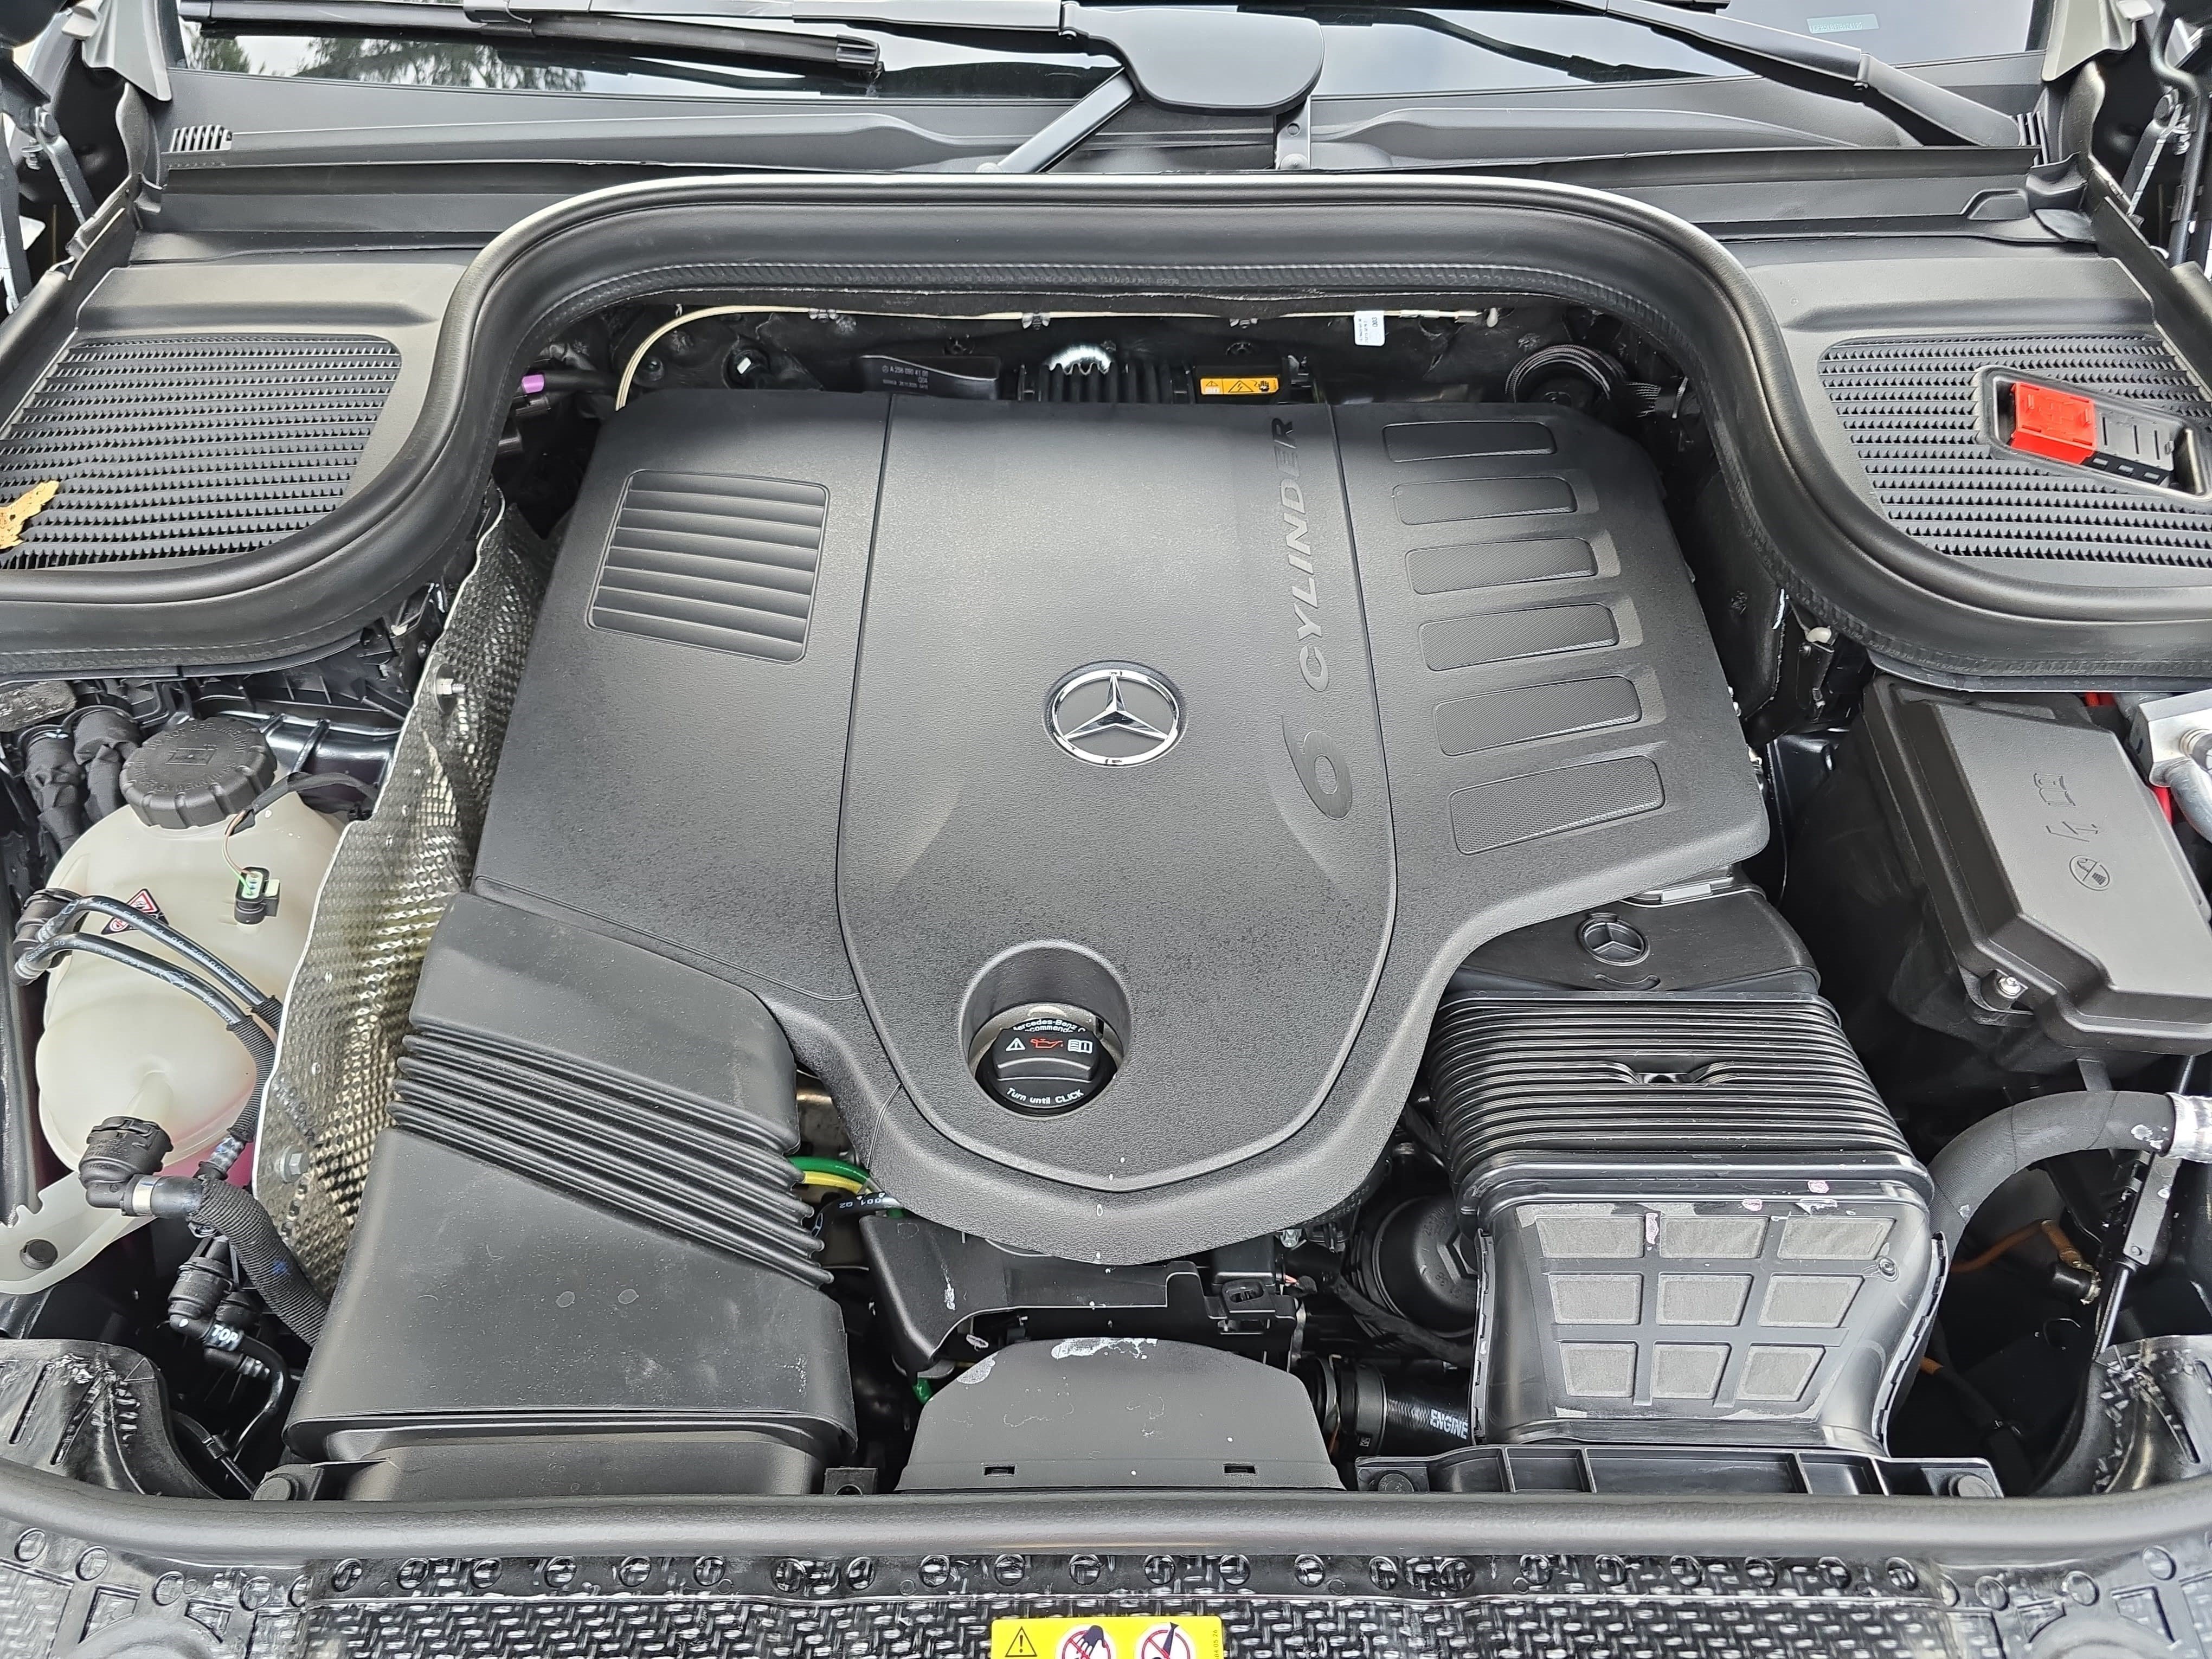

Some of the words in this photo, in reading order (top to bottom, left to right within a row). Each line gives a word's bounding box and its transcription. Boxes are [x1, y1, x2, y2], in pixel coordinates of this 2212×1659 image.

[1272, 417, 1329, 692] CYLINDER
[1282, 715, 1353, 820] 6
[1006, 1087, 1027, 1102] Turn
[1054, 1089, 1084, 1103] CLICK
[211, 1324, 239, 1345] TOP
[1430, 1409, 1469, 1440] ENGINE
